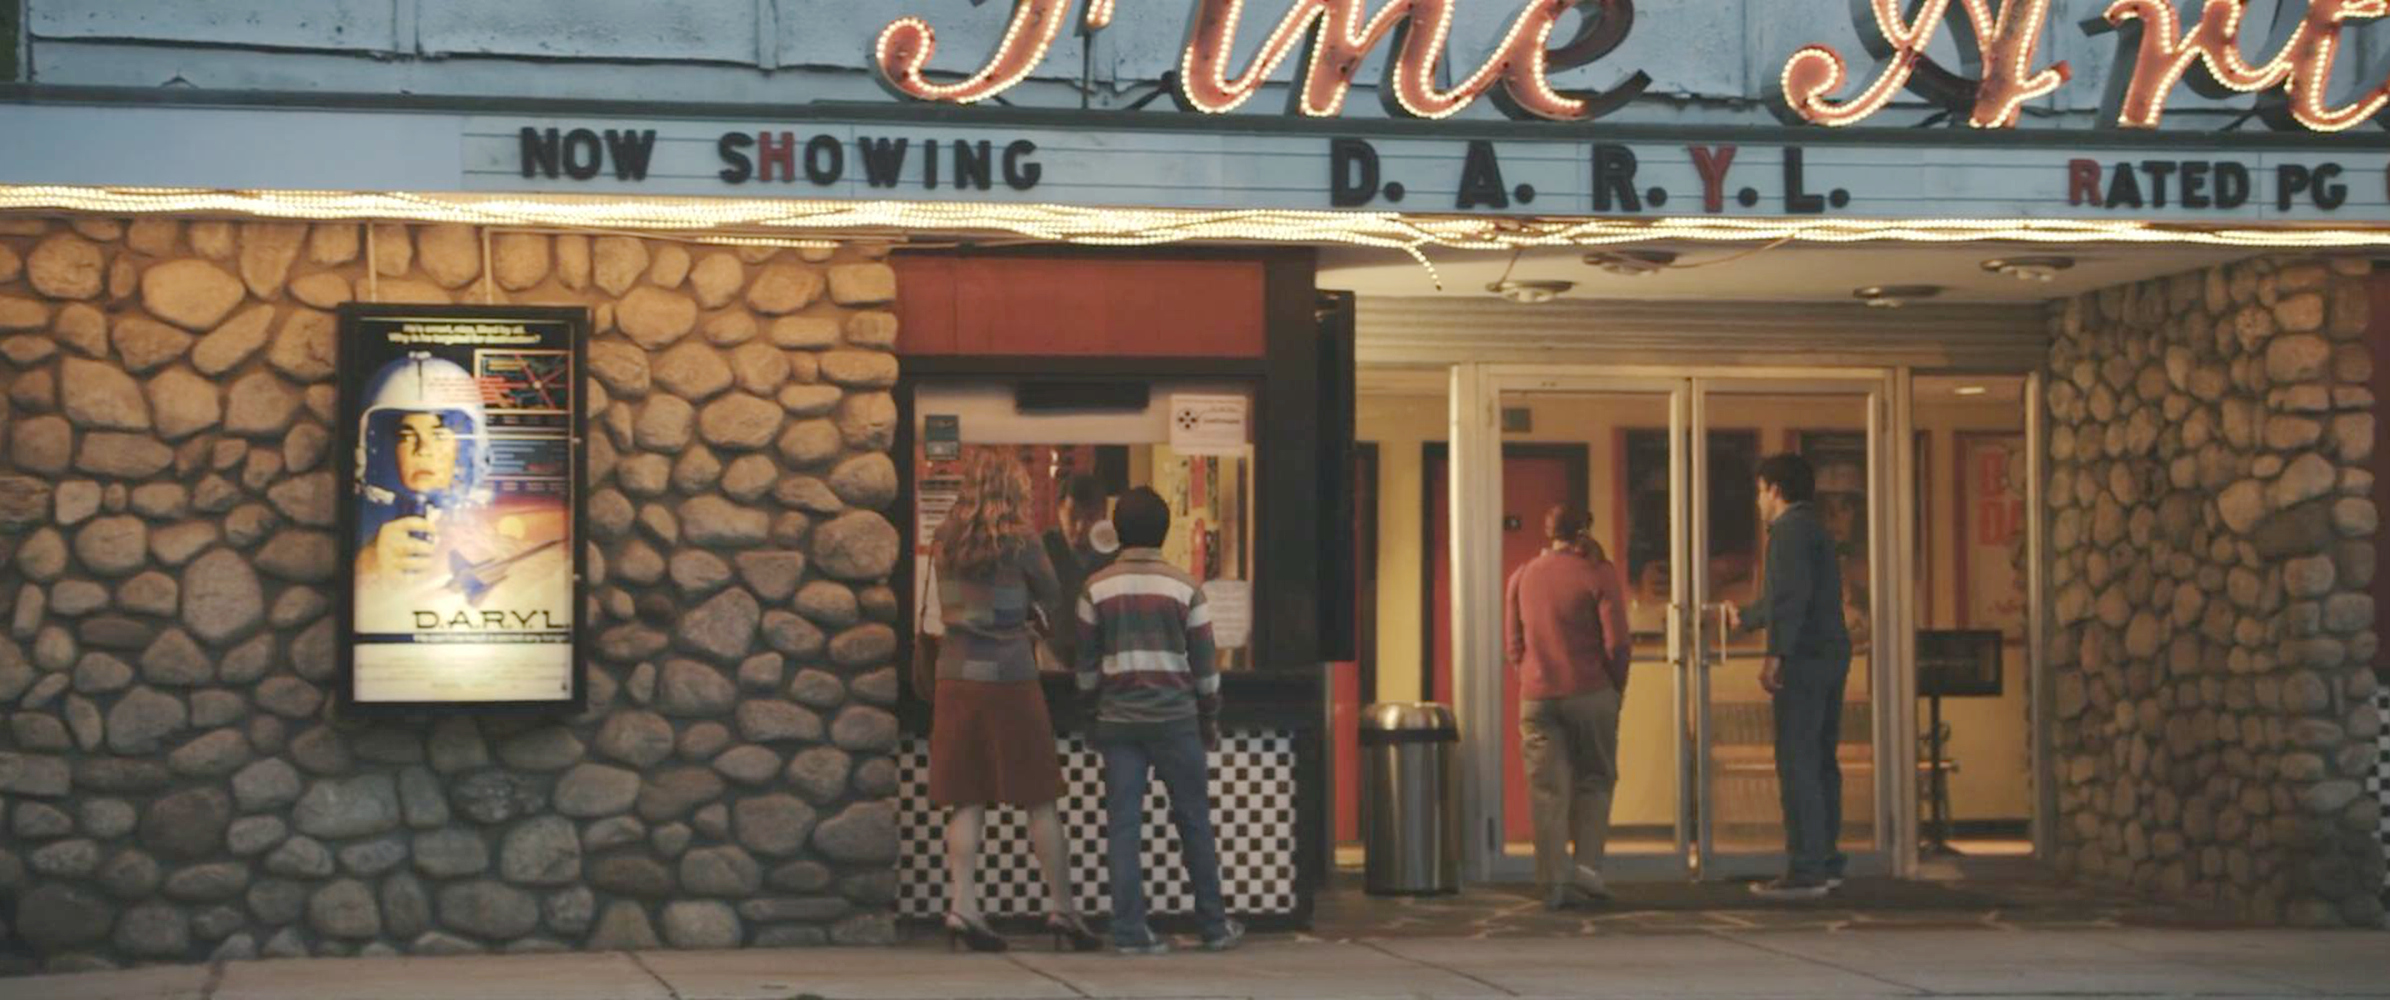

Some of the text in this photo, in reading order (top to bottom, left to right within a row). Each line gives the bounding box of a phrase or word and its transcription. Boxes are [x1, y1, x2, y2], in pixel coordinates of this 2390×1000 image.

[520, 126, 1042, 190] NOW SHOWING
[2068, 158, 2250, 210] RATED
[2277, 162, 2348, 212] PG
